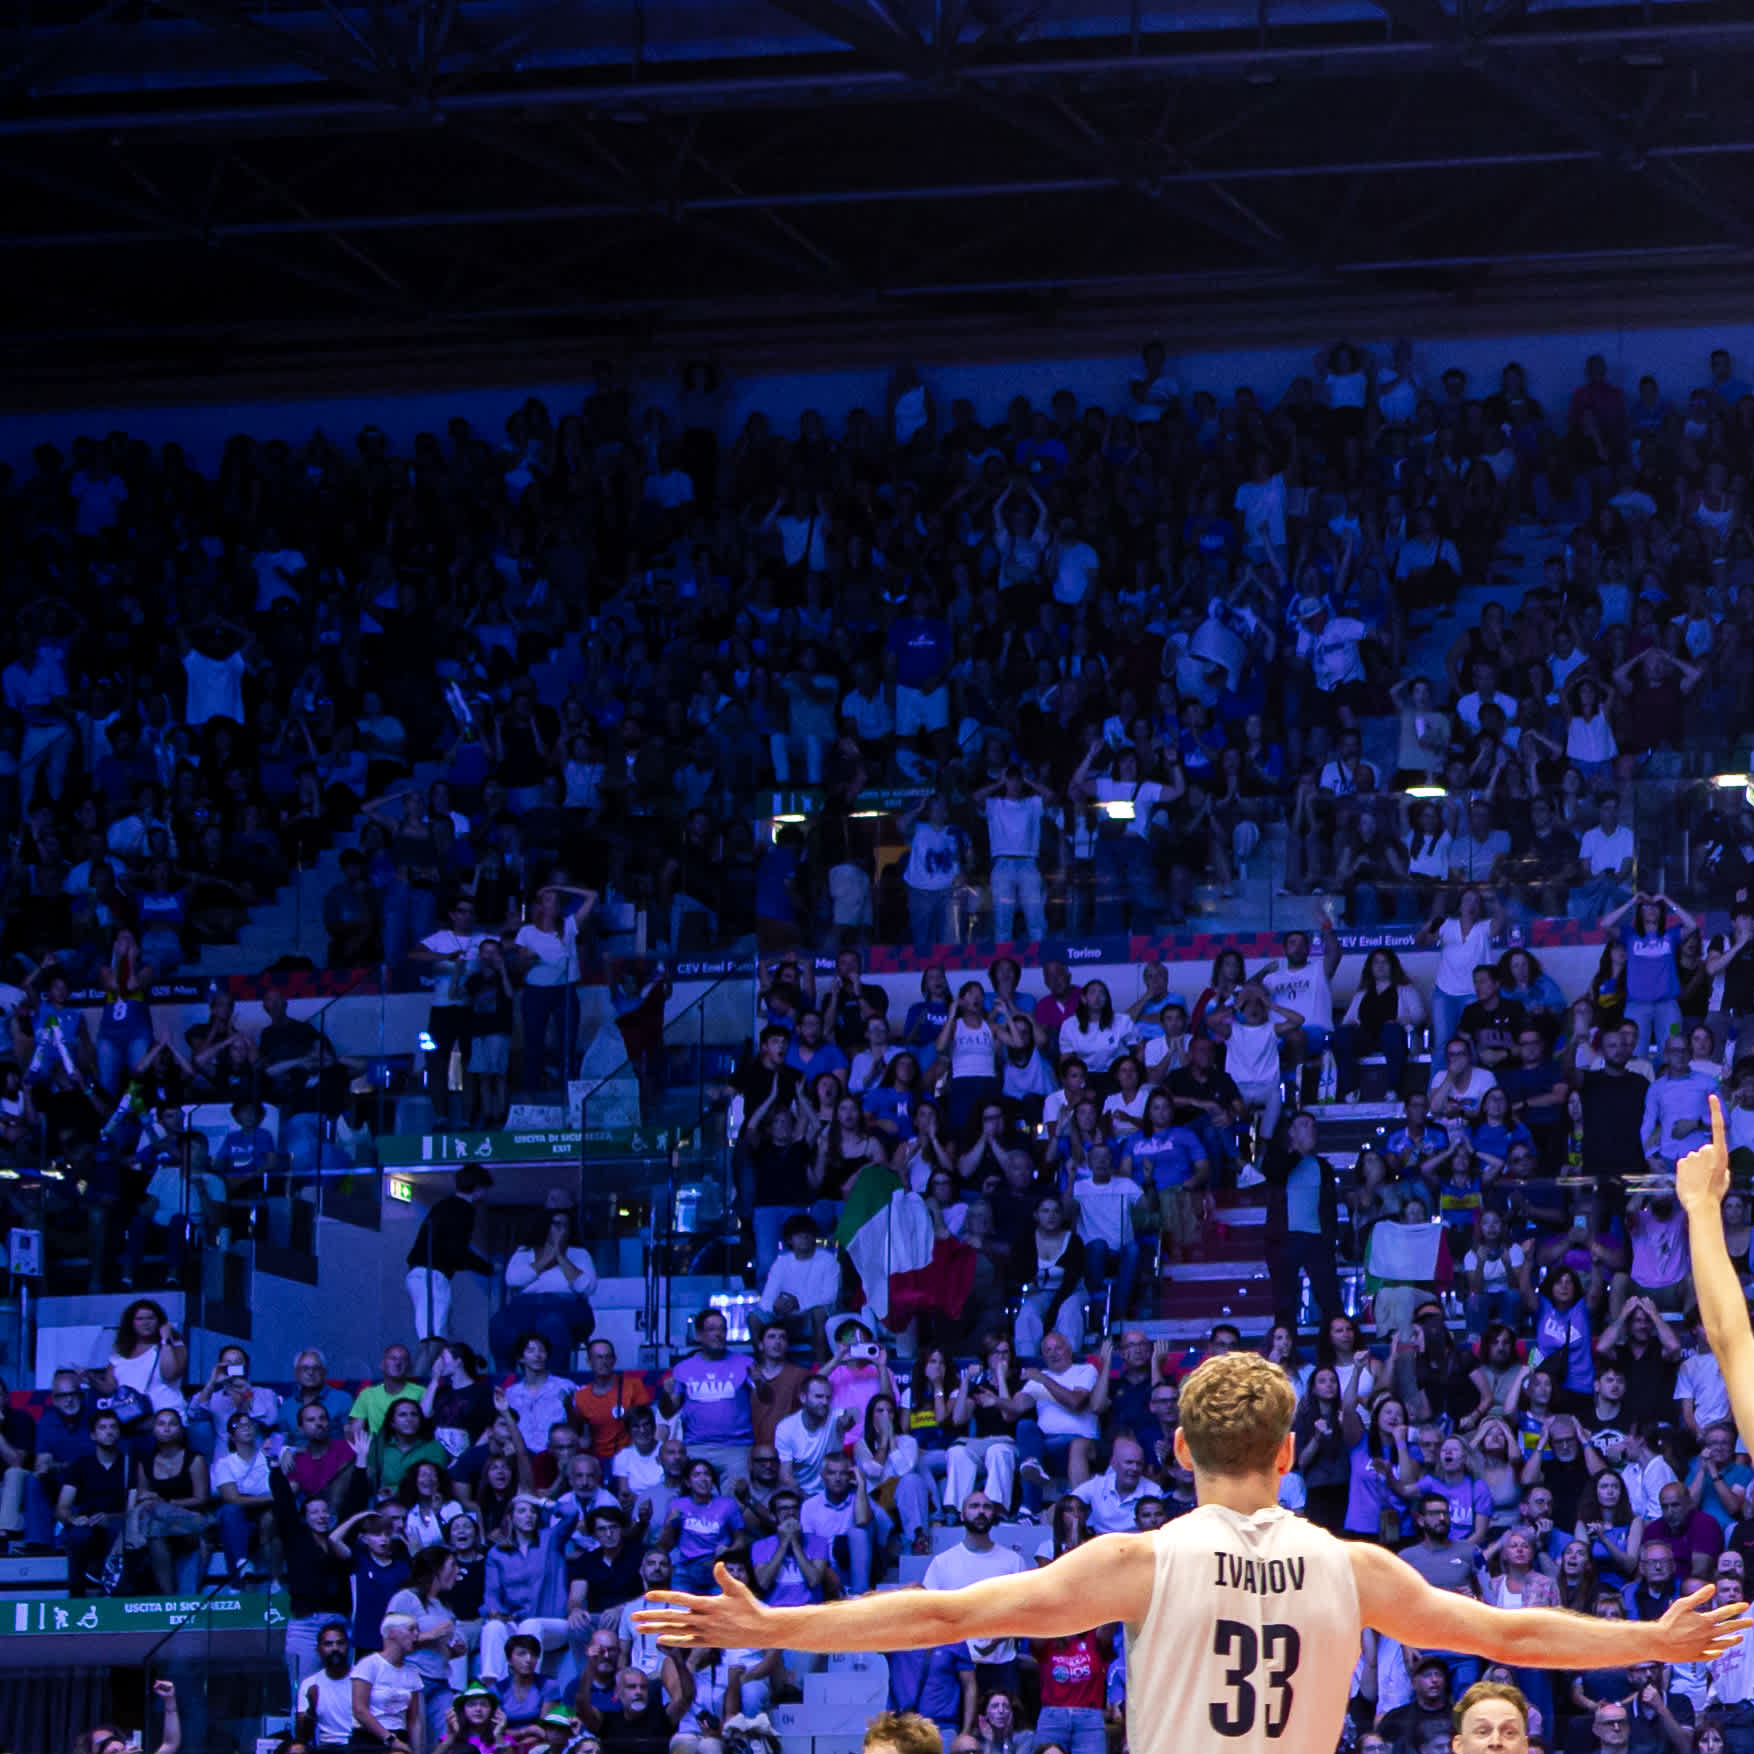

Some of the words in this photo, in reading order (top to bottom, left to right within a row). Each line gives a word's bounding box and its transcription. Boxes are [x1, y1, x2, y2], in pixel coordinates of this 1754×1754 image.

[1339, 936, 1357, 947] EV
[1360, 935, 1382, 947] Enel
[1066, 947, 1102, 960] Torino
[687, 1380, 736, 1398] ITALIA
[125, 1603, 162, 1613] USCITA
[164, 1602, 176, 1611] DI
[1209, 1619, 1301, 1739] 33
